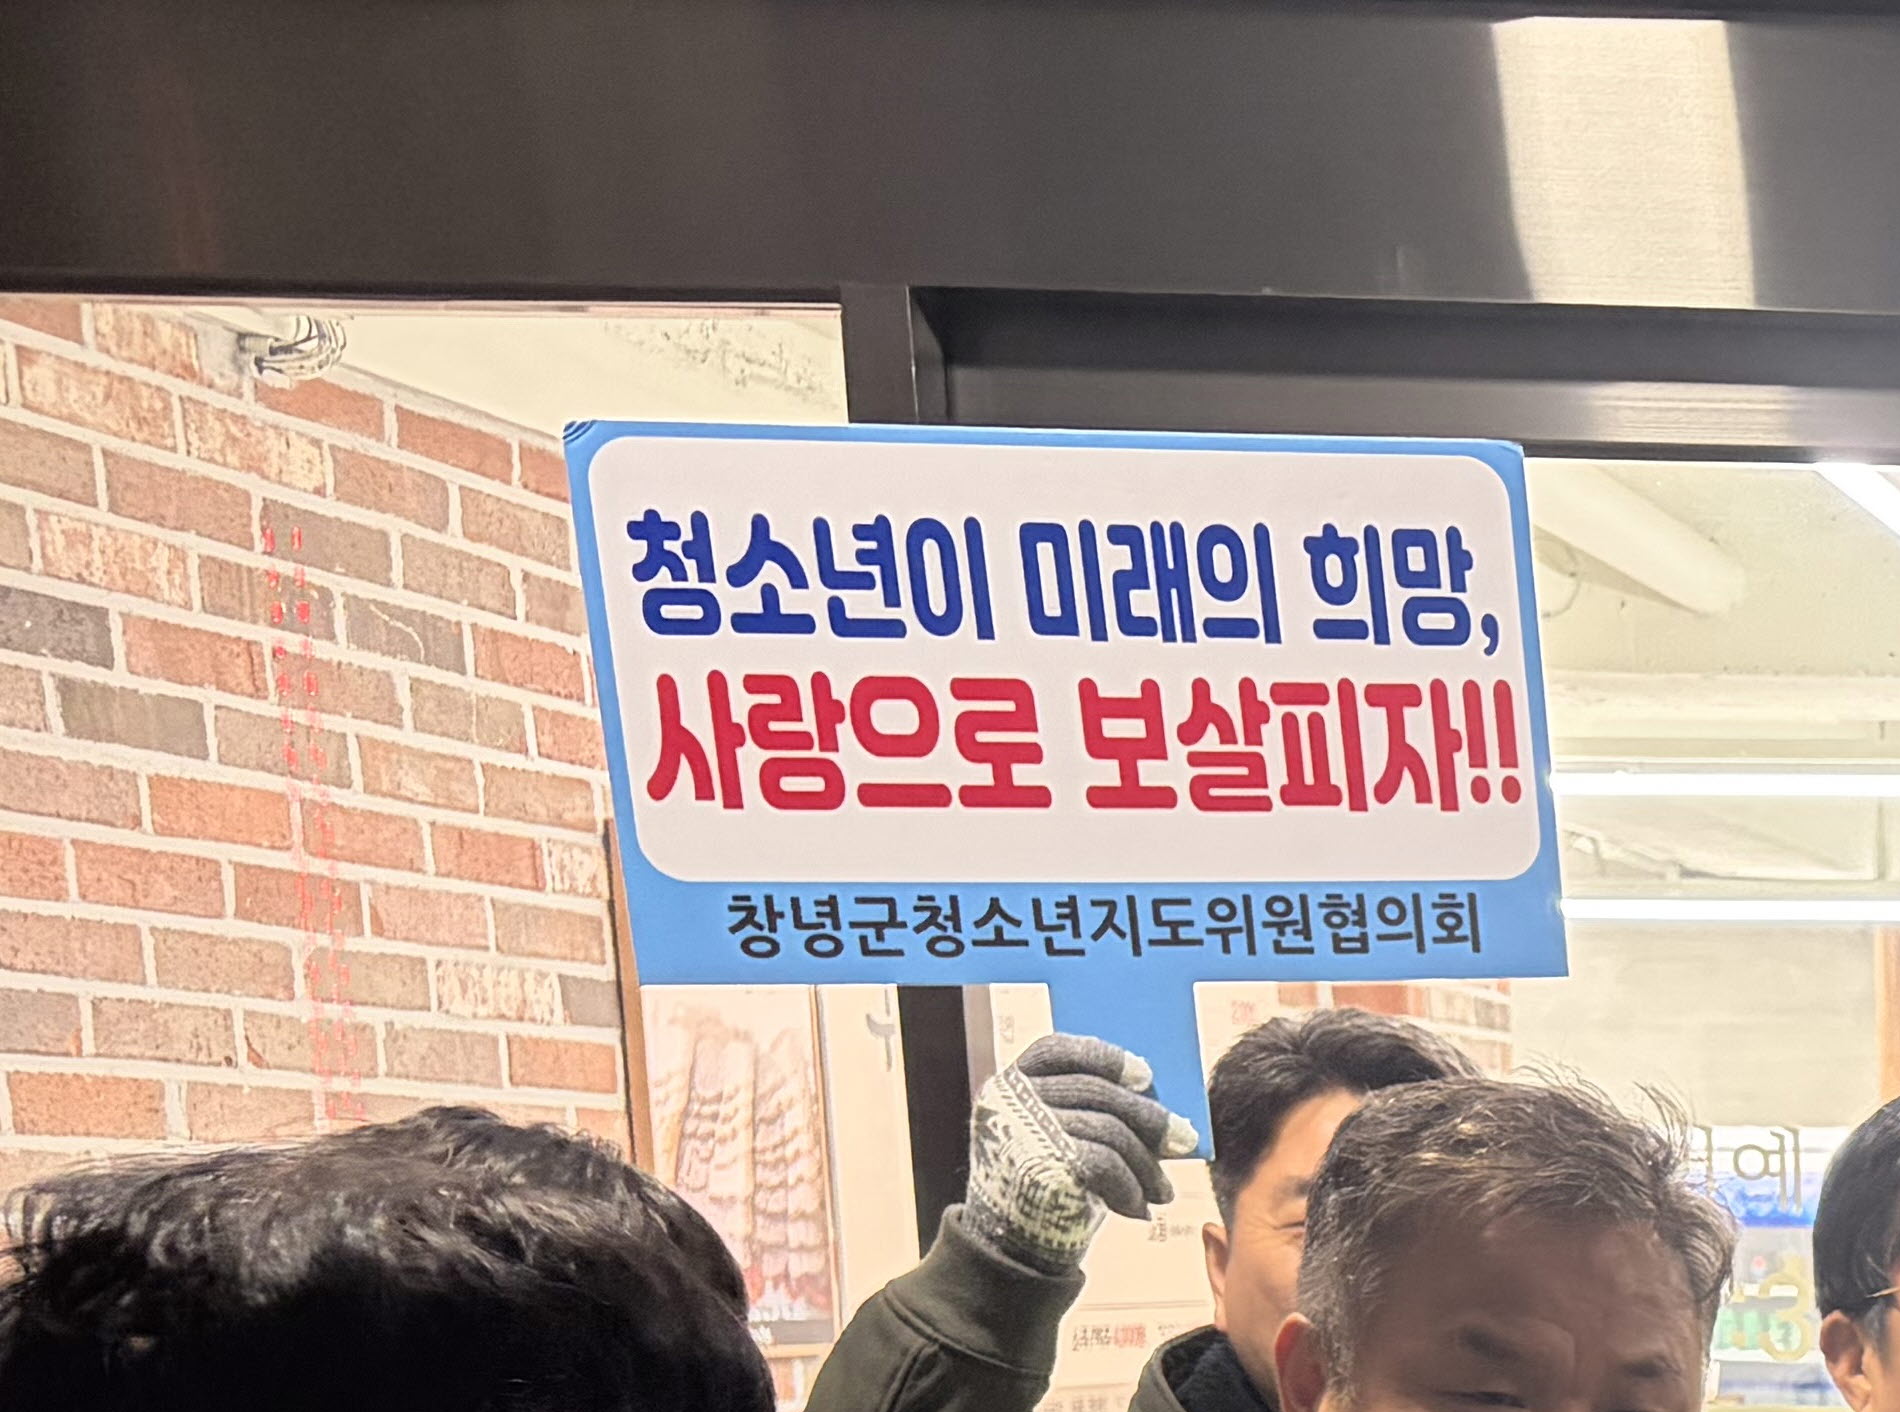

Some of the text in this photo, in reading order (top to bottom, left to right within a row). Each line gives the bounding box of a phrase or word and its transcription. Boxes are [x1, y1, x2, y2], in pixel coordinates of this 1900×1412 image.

[626, 510, 1499, 657] 청소년이 미래의 희망,
[645, 669, 1523, 813] 사랑으로 보살피자!!
[726, 893, 1482, 957] 창녕군청소년지도위원협의회
